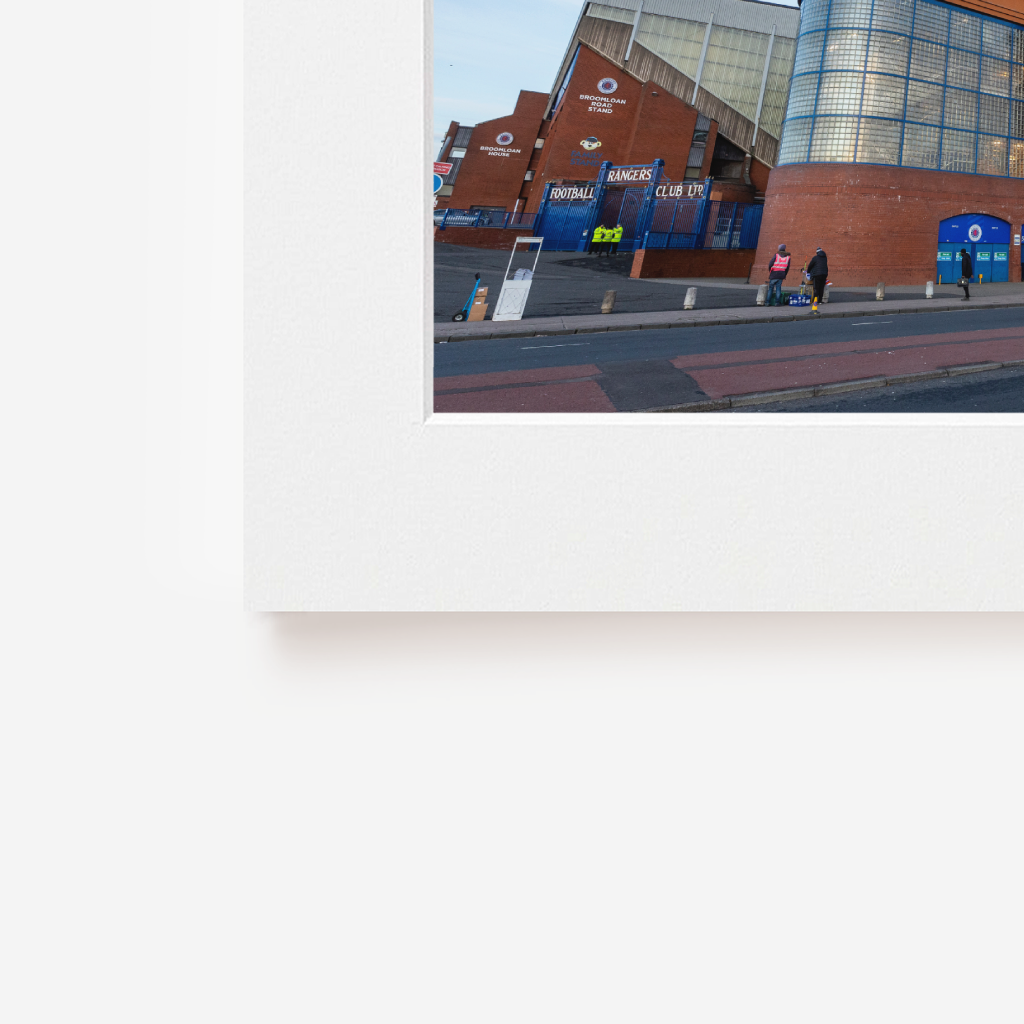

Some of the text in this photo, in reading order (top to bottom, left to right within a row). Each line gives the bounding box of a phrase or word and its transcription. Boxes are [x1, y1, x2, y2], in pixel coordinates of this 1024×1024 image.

[579, 94, 626, 105] BROOMLOAN
[588, 106, 613, 114] STAND
[479, 145, 521, 154] BROOMLOAN
[570, 150, 604, 159] FAMILY
[570, 158, 600, 167] STAND
[606, 169, 652, 182] RANGERS
[549, 187, 595, 199] FOOTBALL
[655, 185, 683, 197] CLUB
